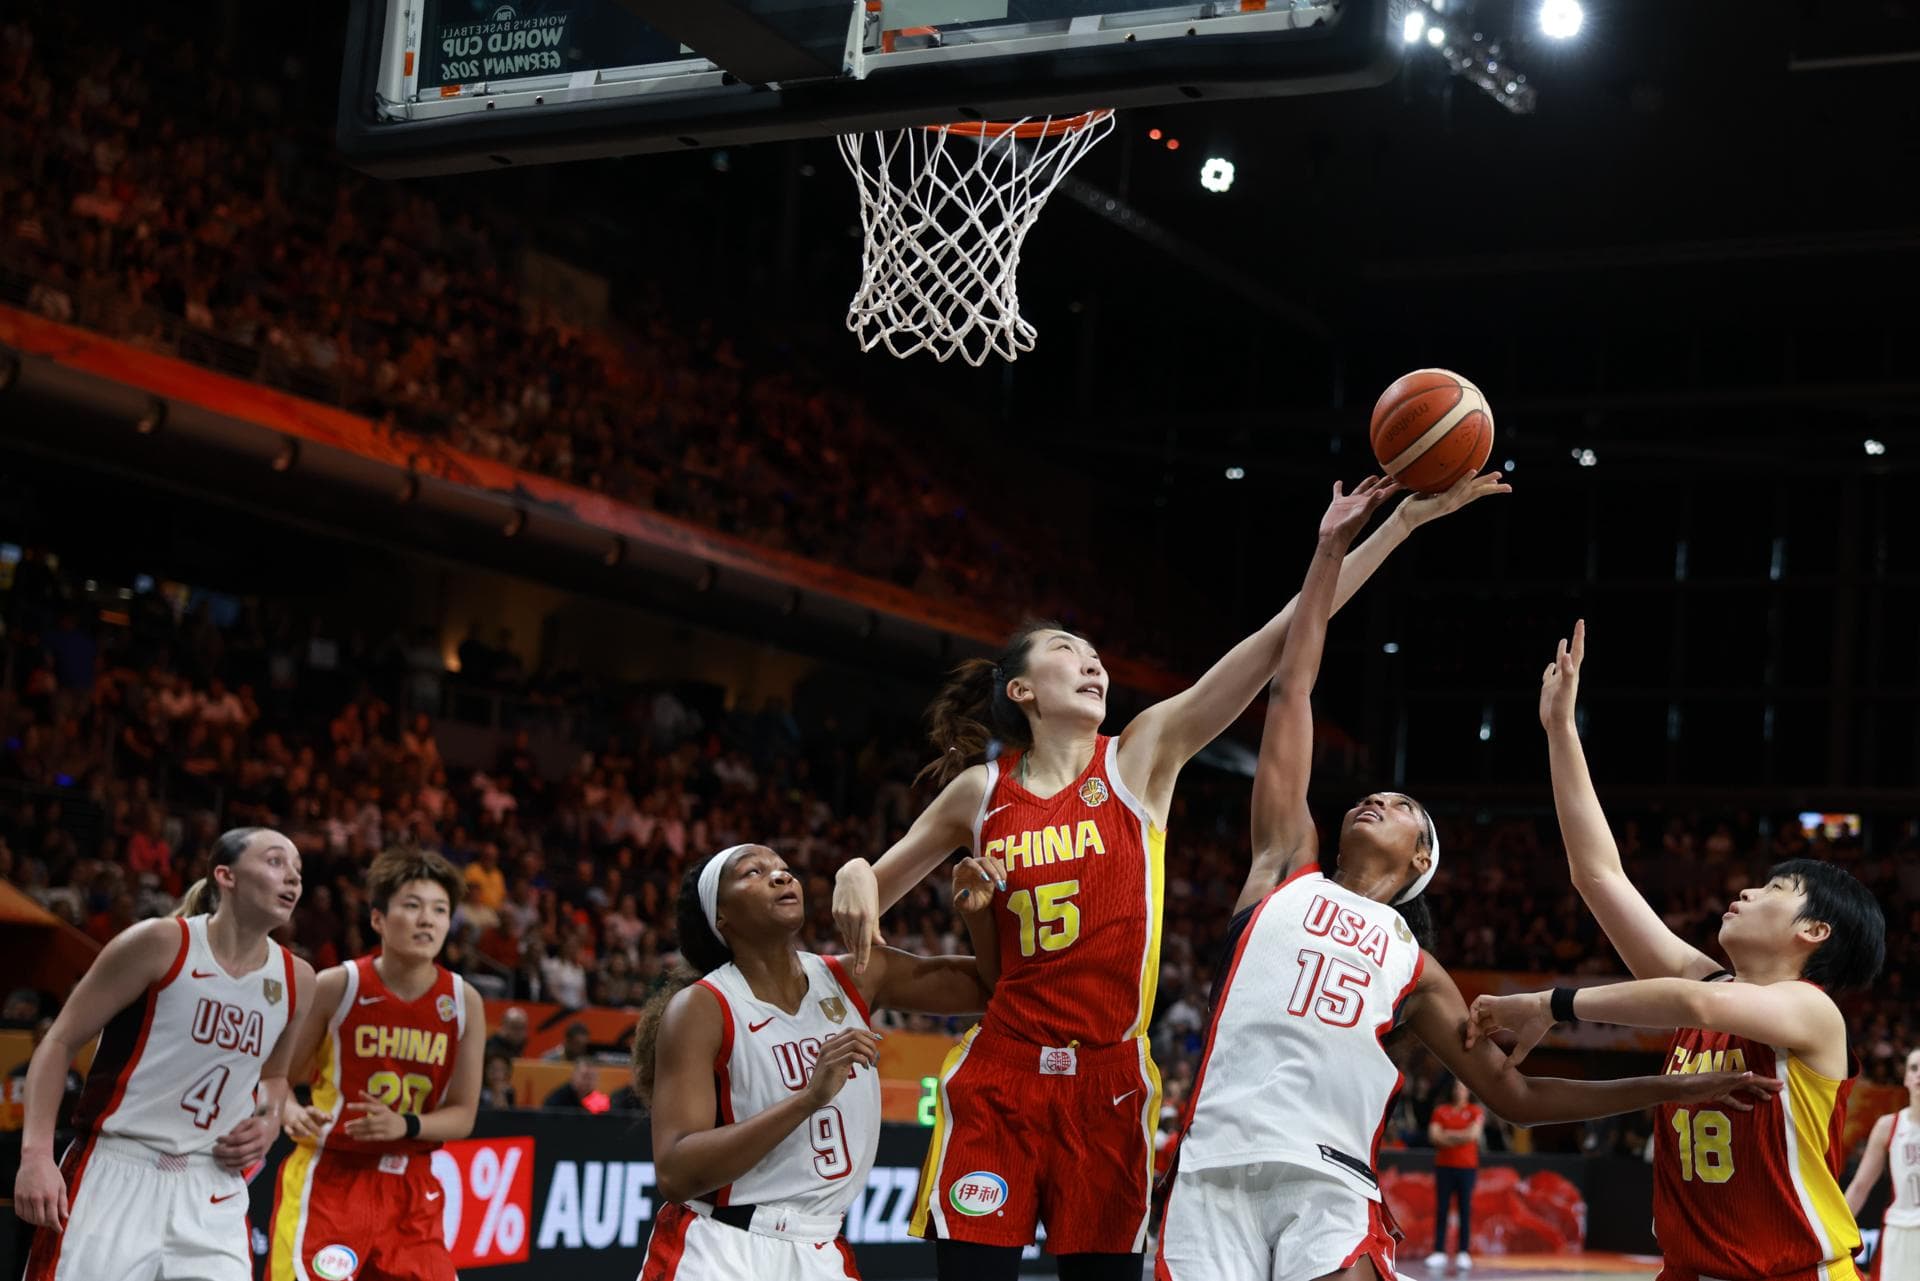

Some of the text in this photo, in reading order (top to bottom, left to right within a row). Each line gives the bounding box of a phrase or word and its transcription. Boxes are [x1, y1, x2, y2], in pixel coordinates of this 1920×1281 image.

[1006, 879, 1080, 957] 15
[1303, 894, 1389, 968] USA
[1287, 948, 1371, 1028] 15
[192, 998, 263, 1057] USA
[355, 1024, 449, 1067] CHINA
[772, 1032, 857, 1091] US
[1665, 1046, 1747, 1076] CHNA
[180, 1064, 230, 1130] 4
[367, 1071, 433, 1119] 20
[810, 1105, 853, 1181] 9
[1671, 1108, 1735, 1184] 18
[536, 1160, 657, 1250] AUF
[958, 1183, 1001, 1204] 伊利
